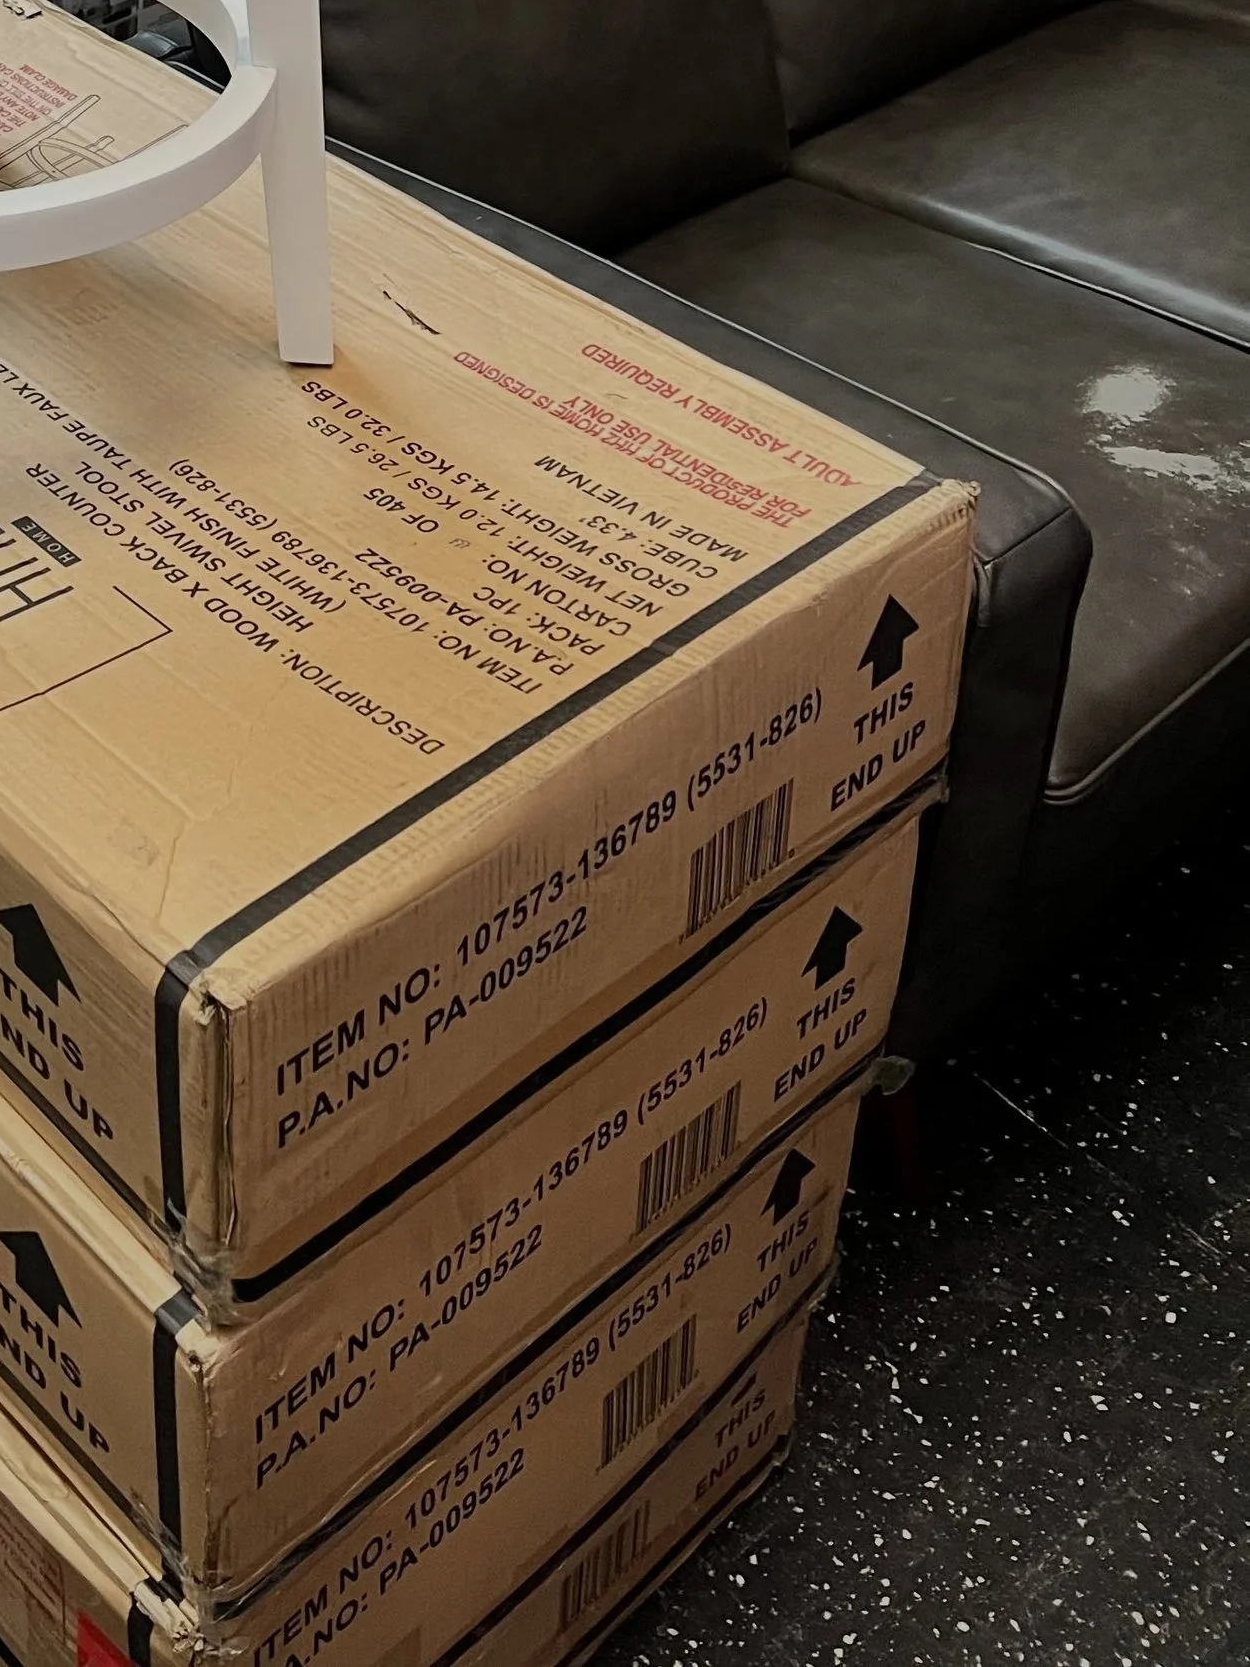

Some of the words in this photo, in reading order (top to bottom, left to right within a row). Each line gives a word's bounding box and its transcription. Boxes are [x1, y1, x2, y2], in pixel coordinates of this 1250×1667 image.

[297, 379, 349, 410] LBS
[450, 350, 539, 399] DESIGNED
[577, 342, 682, 398] REQUIRED
[10, 381, 70, 421] FAUX
[340, 406, 393, 437] 32.0
[529, 394, 558, 410] IS
[547, 404, 606, 437] HOME
[561, 394, 618, 425] ONLY
[673, 393, 789, 453] ASSEMBLY
[61, 419, 135, 469] TAUPE
[303, 414, 355, 444] LBS
[608, 419, 655, 444] USE
[346, 441, 400, 472] 26.5
[397, 440, 455, 475] KGS
[634, 450, 669, 470] OF
[646, 438, 769, 501] RESIDENTIAL
[782, 448, 862, 490] ADULT
[22, 462, 128, 538] COUNTER
[66, 460, 146, 514] STOOL
[126, 467, 190, 509] WITH
[164, 457, 280, 532] (5531-826)
[361, 485, 410, 514] 405
[404, 475, 462, 510] KGS
[448, 470, 505, 503] 14.5
[531, 454, 646, 515] VIETNAM
[663, 465, 757, 511] PRODUCT
[764, 494, 811, 518] FOR
[181, 506, 261, 559] FINISH
[402, 509, 442, 534] OF
[455, 507, 510, 538] 12.0
[496, 497, 601, 555] WEIGHT:
[639, 509, 674, 530] IN
[751, 504, 797, 528] THE
[20, 522, 75, 562] HOME
[118, 534, 189, 584] BACK
[138, 510, 229, 573] SWIVEL
[503, 535, 609, 591] WEIGHT:
[635, 538, 722, 580] CUBE:
[668, 523, 750, 562] MADE
[181, 580, 210, 598] X
[254, 556, 348, 614] (WHITE
[267, 528, 435, 635] 107573-136789
[352, 546, 486, 627] PA-009522
[476, 553, 528, 583] NO:
[596, 550, 693, 598] GROSS
[200, 594, 282, 651] WOOD
[220, 569, 315, 632] HEIGHT
[469, 584, 526, 616] 1PC
[521, 578, 635, 637] CARTON
[602, 586, 664, 617] NET
[428, 628, 482, 660] NO:
[478, 621, 575, 675] P.A.NO:
[522, 610, 606, 656] PACK:
[475, 655, 544, 694] ITEM
[275, 647, 445, 755] DESCRIPTION:
[850, 677, 915, 750] THIS
[829, 747, 886, 814] END
[890, 715, 927, 768] UP
[276, 1005, 366, 1099] ITEM
[378, 954, 441, 1027] NO:
[455, 784, 678, 972] 107573-136789
[685, 682, 824, 816] (5531-826)
[276, 1027, 411, 1152] P.A.NO:
[422, 901, 588, 1049] PA-009522
[794, 972, 857, 1044] THIS
[771, 1038, 827, 1105] END
[832, 1003, 868, 1055] UP
[65, 1079, 114, 1141] UP
[255, 1349, 336, 1446] ITEM
[346, 1292, 405, 1366] NO:
[417, 1103, 629, 1305] 107573-136789
[636, 991, 770, 1129] (5531-826)
[753, 1206, 811, 1278] THIS
[735, 1272, 782, 1336] END
[786, 1234, 819, 1283] UP
[255, 1363, 376, 1491] P.A.NO:
[388, 1218, 544, 1375] PA-009522
[59, 1391, 111, 1454] UP
[253, 1584, 328, 1667] ITEM
[338, 1523, 394, 1596] NO:
[403, 1331, 602, 1536] 107573-136789
[604, 1216, 735, 1358] (5531-826)
[715, 1388, 766, 1449] THIS
[695, 1444, 740, 1502] END
[747, 1409, 777, 1449] UP
[378, 1442, 526, 1597] PA-009522
